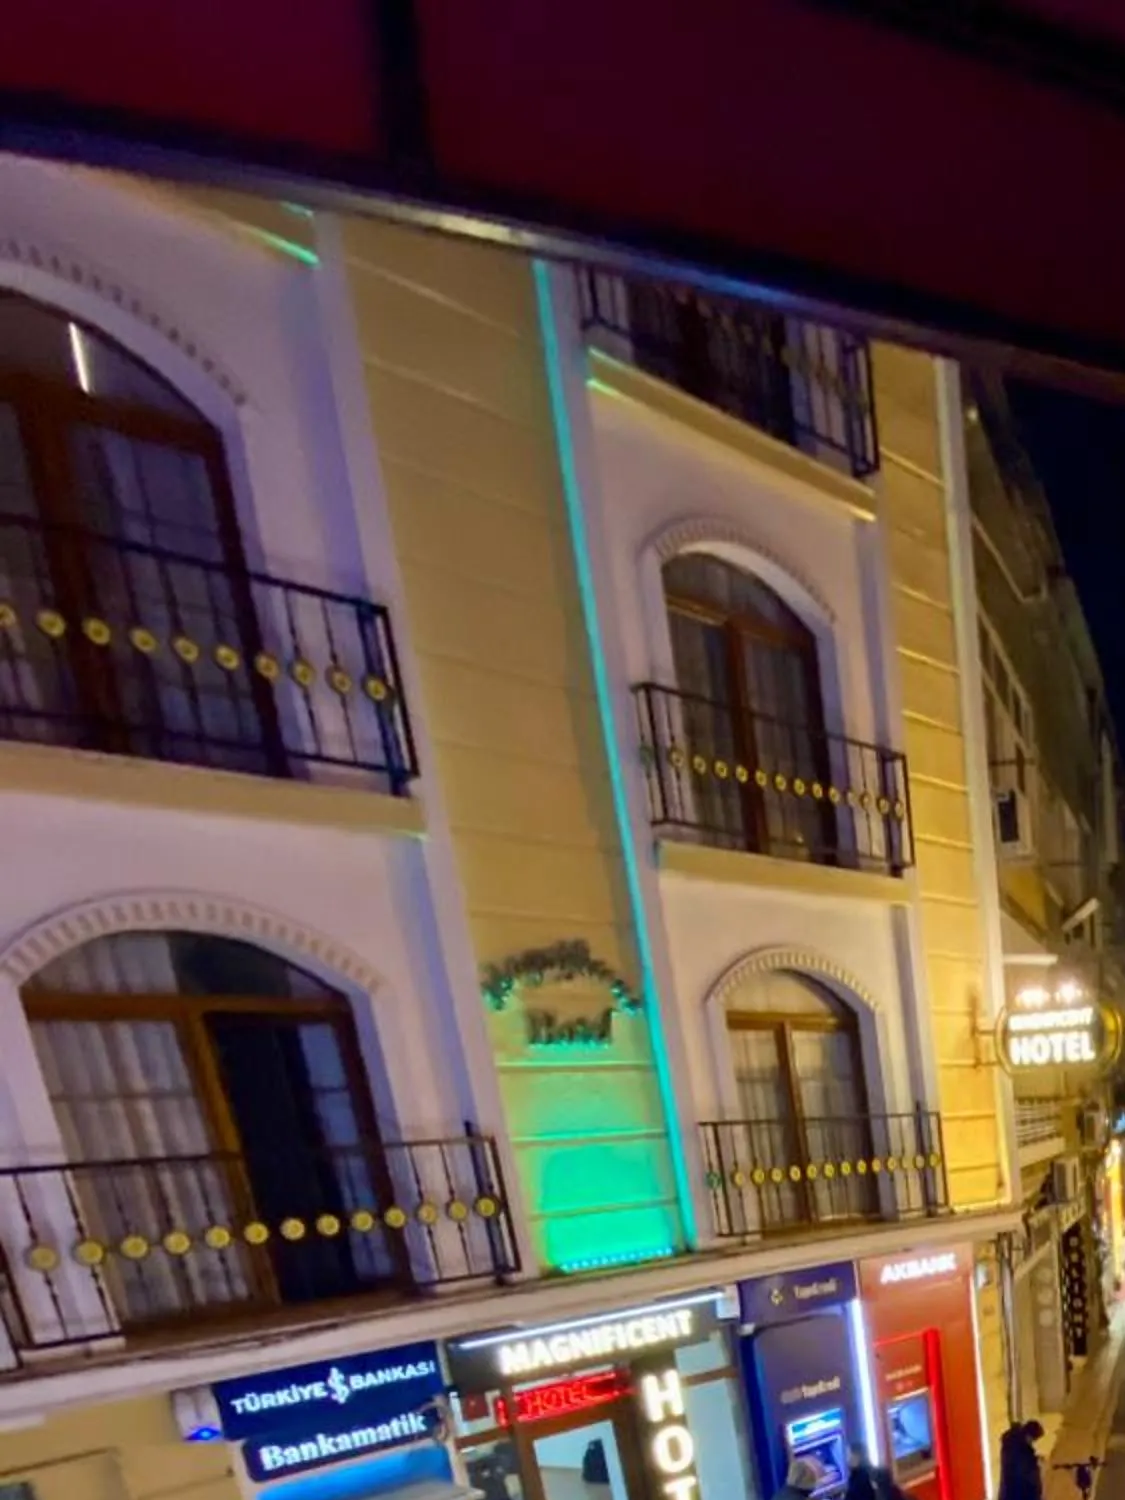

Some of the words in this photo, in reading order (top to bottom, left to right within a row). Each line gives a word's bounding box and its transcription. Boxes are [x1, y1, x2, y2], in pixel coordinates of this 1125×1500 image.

[1009, 1031, 1097, 1066] HOTEL
[499, 1309, 693, 1375] MAGNIFICENT
[229, 1383, 328, 1415] TÜRKİYE
[350, 1360, 436, 1391] BANKASI
[525, 1380, 588, 1418] HOTEL
[259, 1412, 428, 1471] Bankamatik
